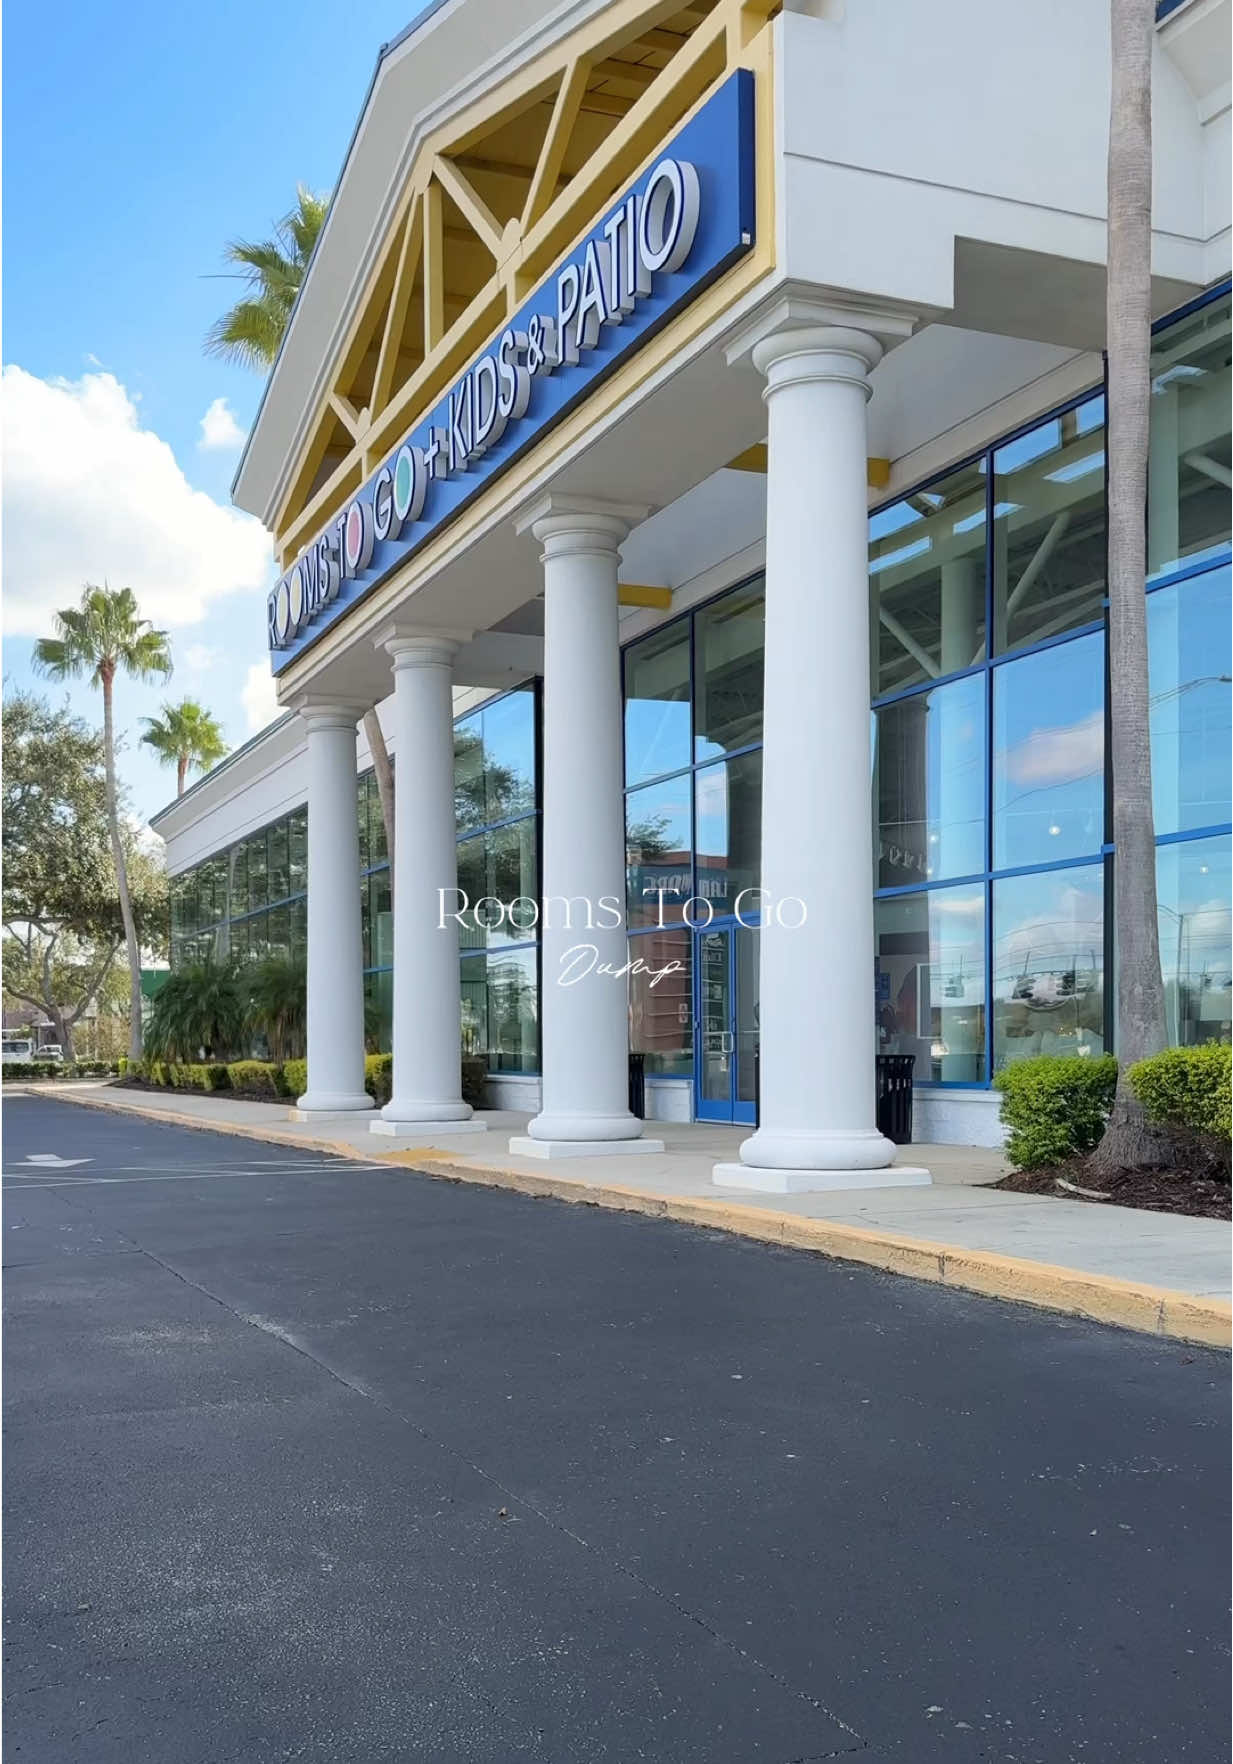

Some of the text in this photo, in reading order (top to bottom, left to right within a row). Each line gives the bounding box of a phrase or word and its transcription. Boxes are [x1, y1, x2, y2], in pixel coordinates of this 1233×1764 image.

[266, 158, 693, 650] ROOMS TO GO + KIDS & PATIO
